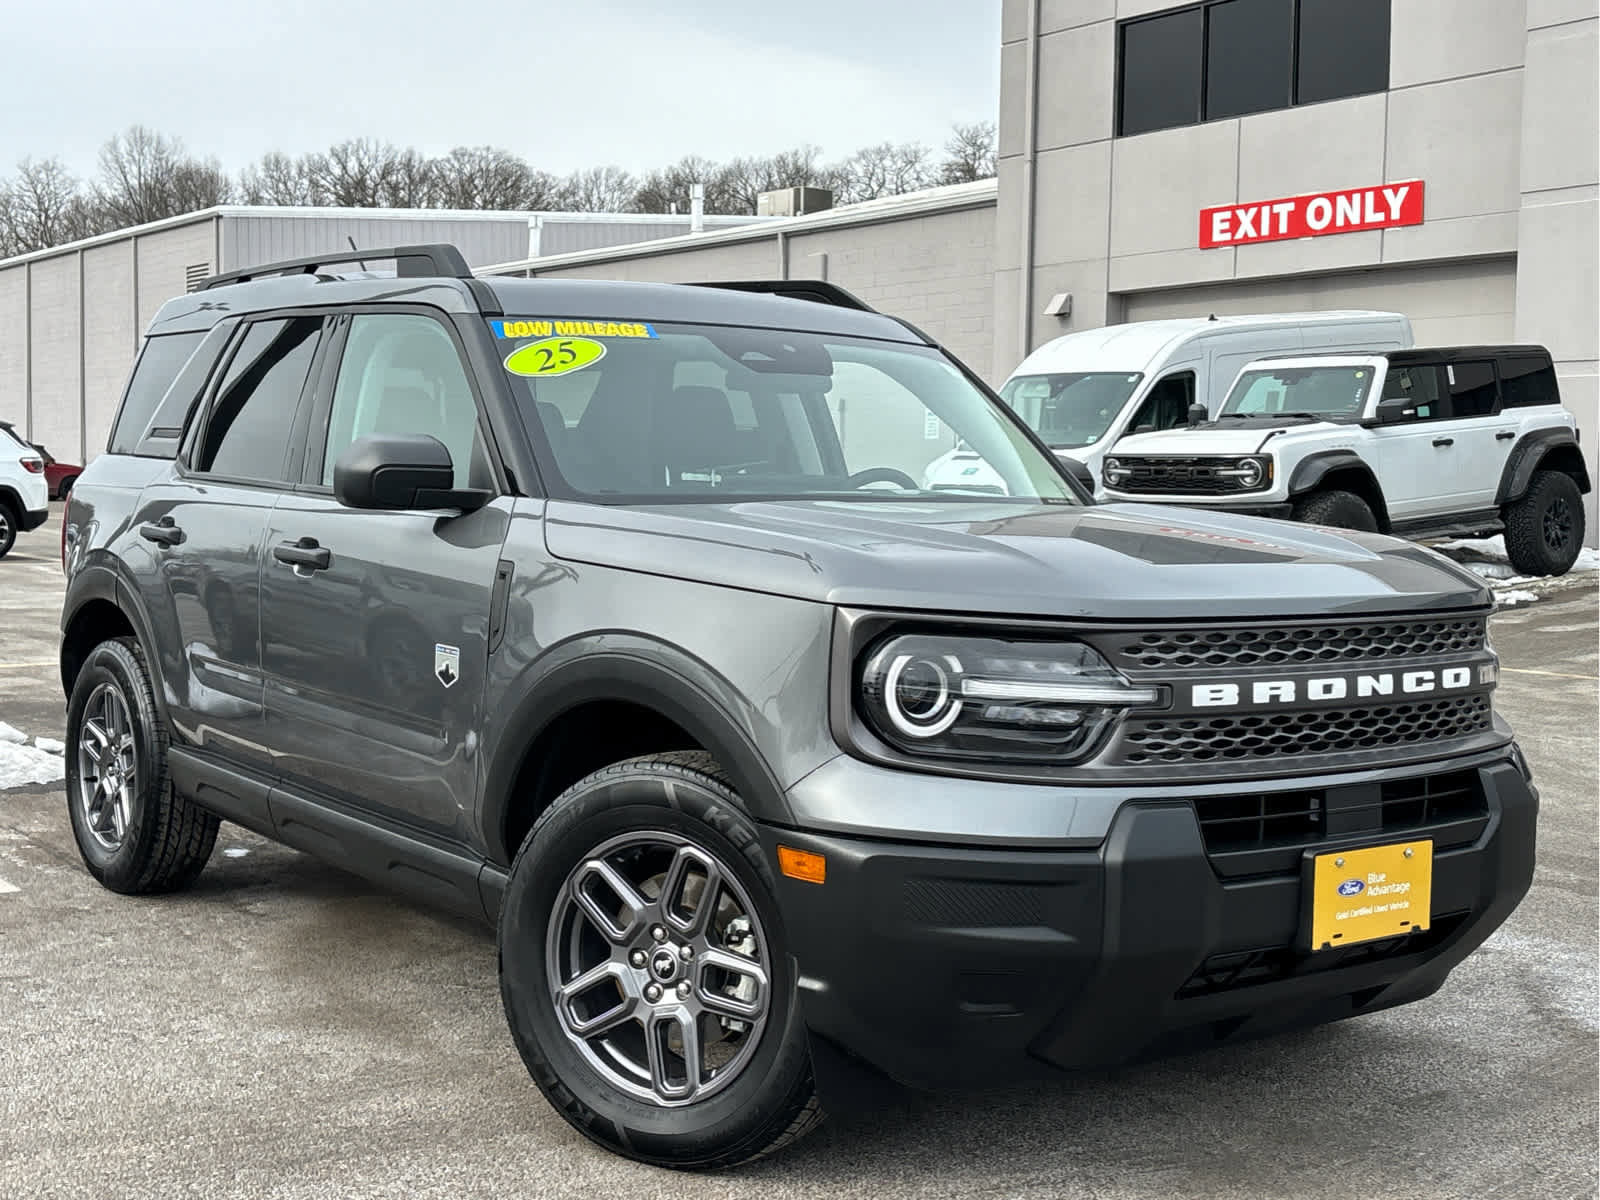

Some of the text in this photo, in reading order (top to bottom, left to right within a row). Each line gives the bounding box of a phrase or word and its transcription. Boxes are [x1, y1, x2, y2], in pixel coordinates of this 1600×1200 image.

[1211, 186, 1410, 242] EXIT ONLY
[503, 321, 650, 338] LOW MILEAGE
[535, 341, 577, 372] 25
[1191, 667, 1471, 707] BRONCO
[1367, 872, 1386, 884] Blue
[1340, 881, 1362, 895] Ford
[1367, 882, 1410, 896] Advantage
